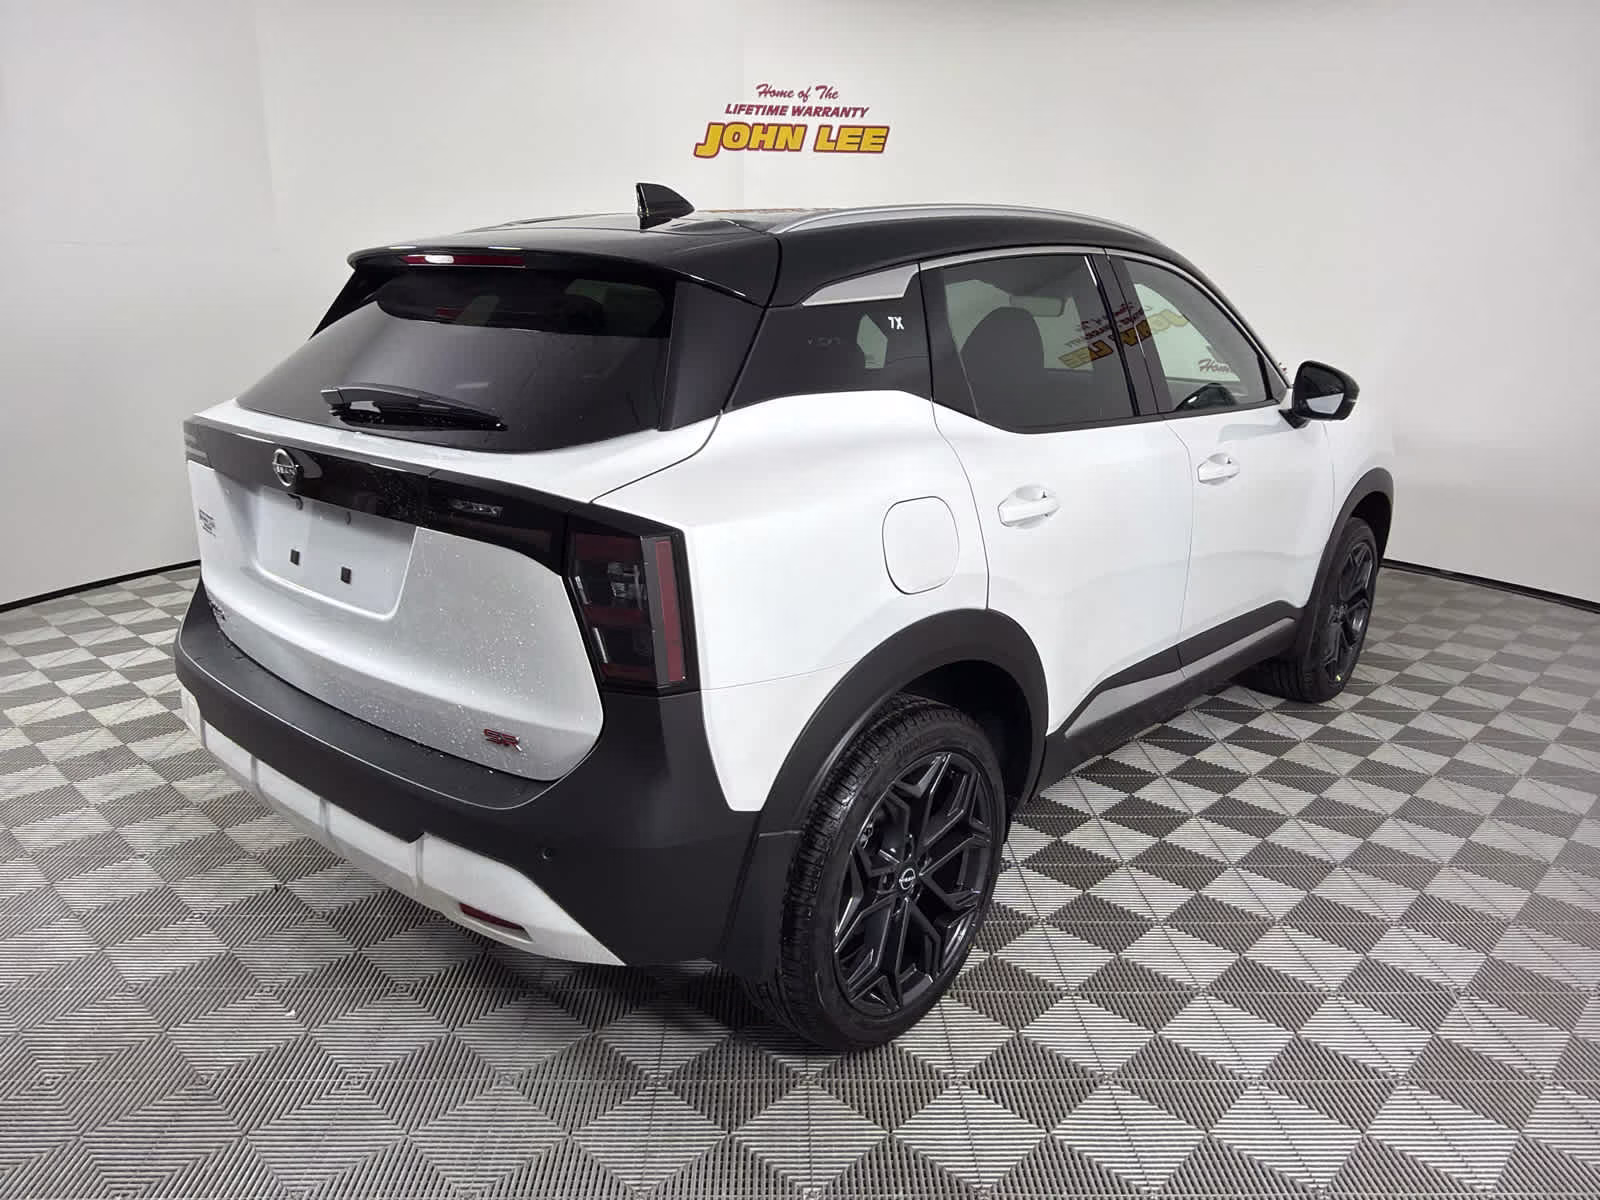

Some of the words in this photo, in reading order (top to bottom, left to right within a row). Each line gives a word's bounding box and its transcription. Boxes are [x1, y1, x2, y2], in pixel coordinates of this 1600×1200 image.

[756, 83, 795, 98] Home
[798, 86, 811, 102] of
[815, 85, 839, 100] The
[725, 103, 789, 116] LIFETIME
[791, 105, 870, 118] WARRANTY
[694, 121, 808, 158] JOHN
[813, 124, 890, 153] LEE
[888, 316, 904, 330] TX
